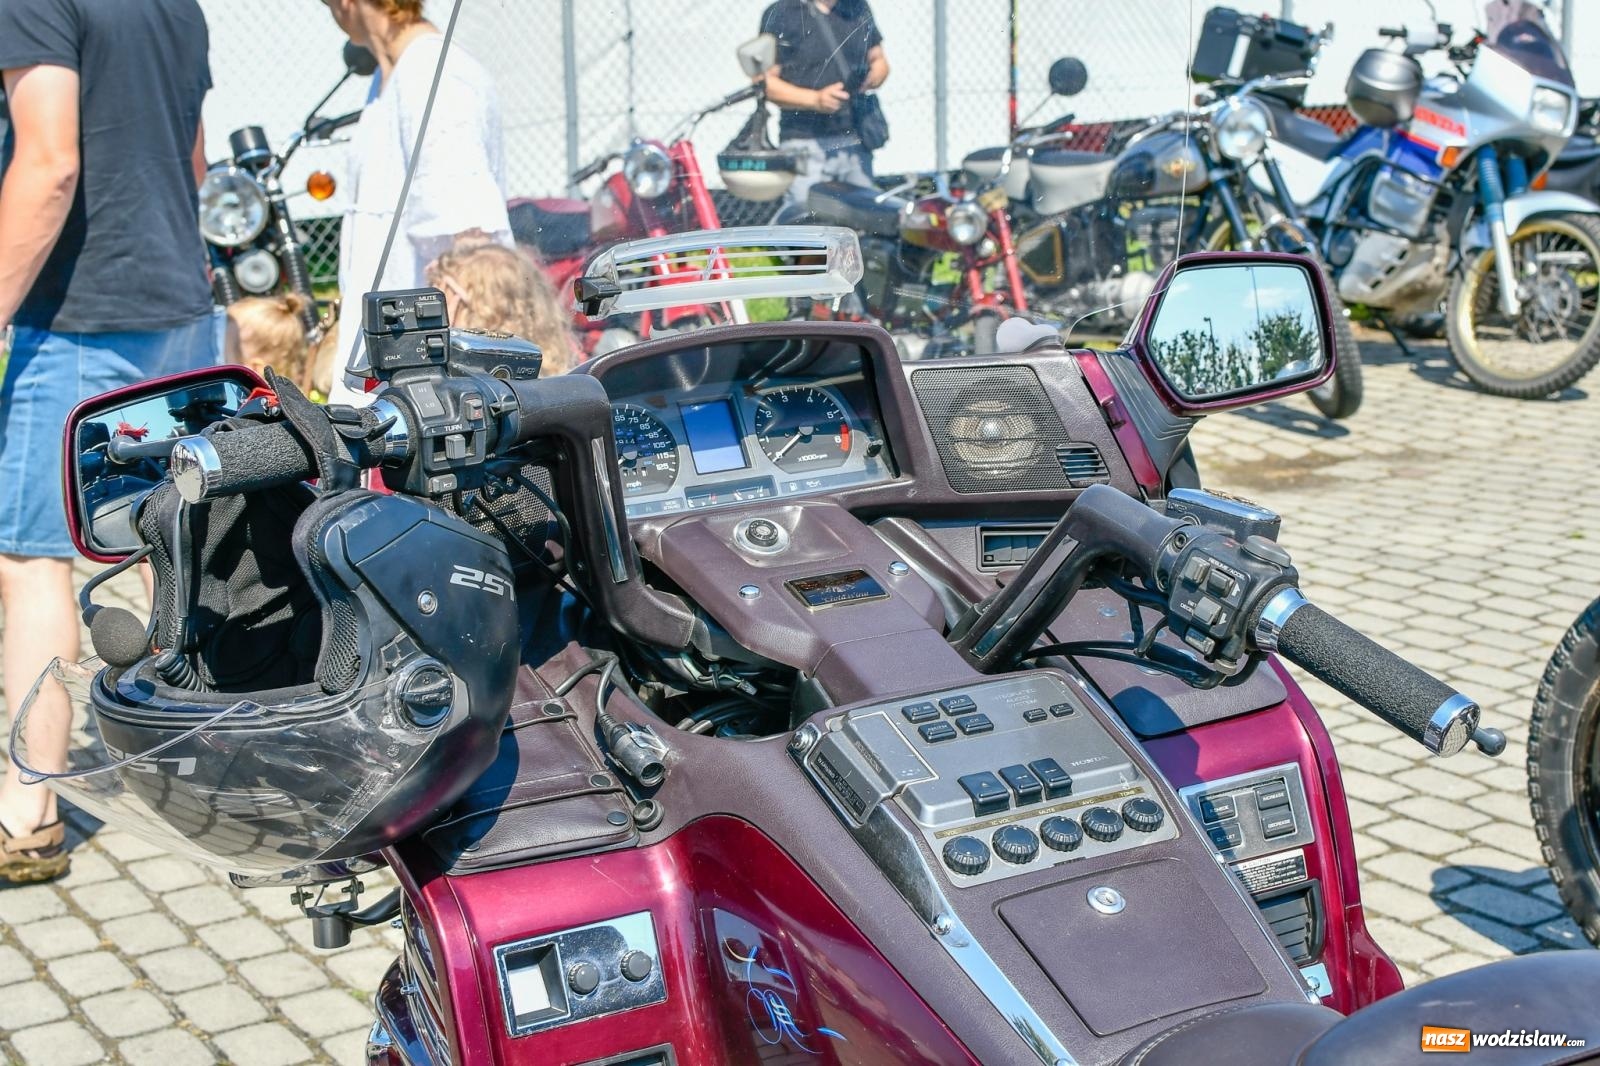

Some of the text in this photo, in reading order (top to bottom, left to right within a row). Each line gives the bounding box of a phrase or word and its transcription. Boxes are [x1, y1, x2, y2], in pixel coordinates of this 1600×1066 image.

[782, 395, 789, 403] 3
[614, 414, 626, 422] 65
[765, 410, 773, 418] 2
[826, 411, 834, 419] 5
[628, 416, 639, 424] 75
[444, 424, 463, 432] TURN
[648, 431, 659, 439] 95
[652, 441, 666, 449] 105
[656, 463, 669, 471] 125
[626, 480, 642, 488] mph
[1070, 755, 1109, 767] HONDA
[1262, 792, 1285, 801] INCREASE
[1038, 808, 1056, 816] MUTE
[1267, 819, 1291, 828] DECREASE
